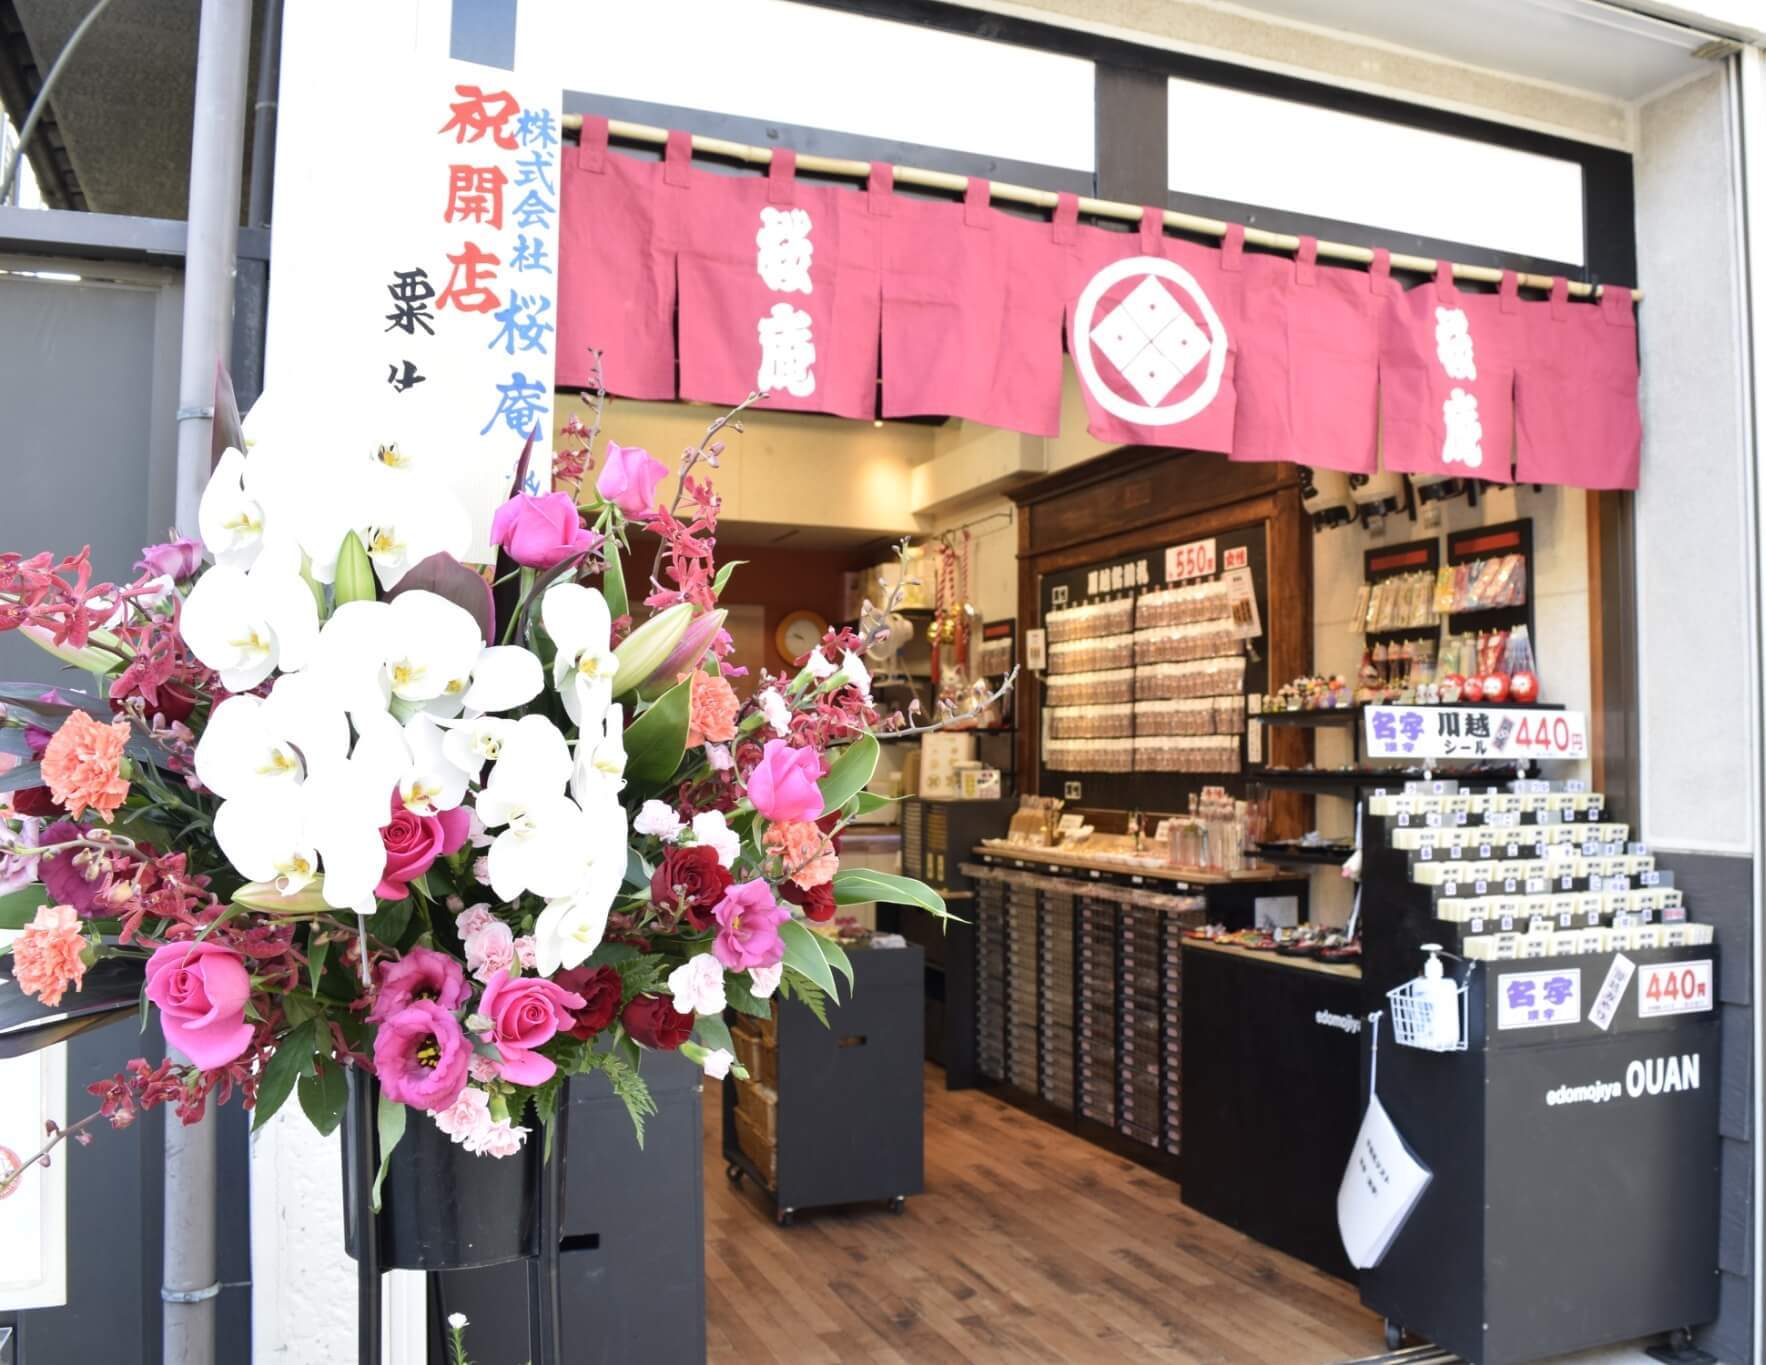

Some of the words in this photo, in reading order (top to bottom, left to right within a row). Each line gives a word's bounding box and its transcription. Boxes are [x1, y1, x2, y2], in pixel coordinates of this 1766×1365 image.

[435, 84, 521, 316] 祝開店
[480, 107, 559, 496] 株式会社桜庵
[1371, 711, 1425, 741] 名字
[1438, 711, 1491, 739] 川越
[1444, 740, 1488, 755] シール
[1506, 976, 1573, 1009] 名字
[1546, 1080, 1622, 1106] edomojiya
[1625, 1053, 1701, 1098] OUAN
